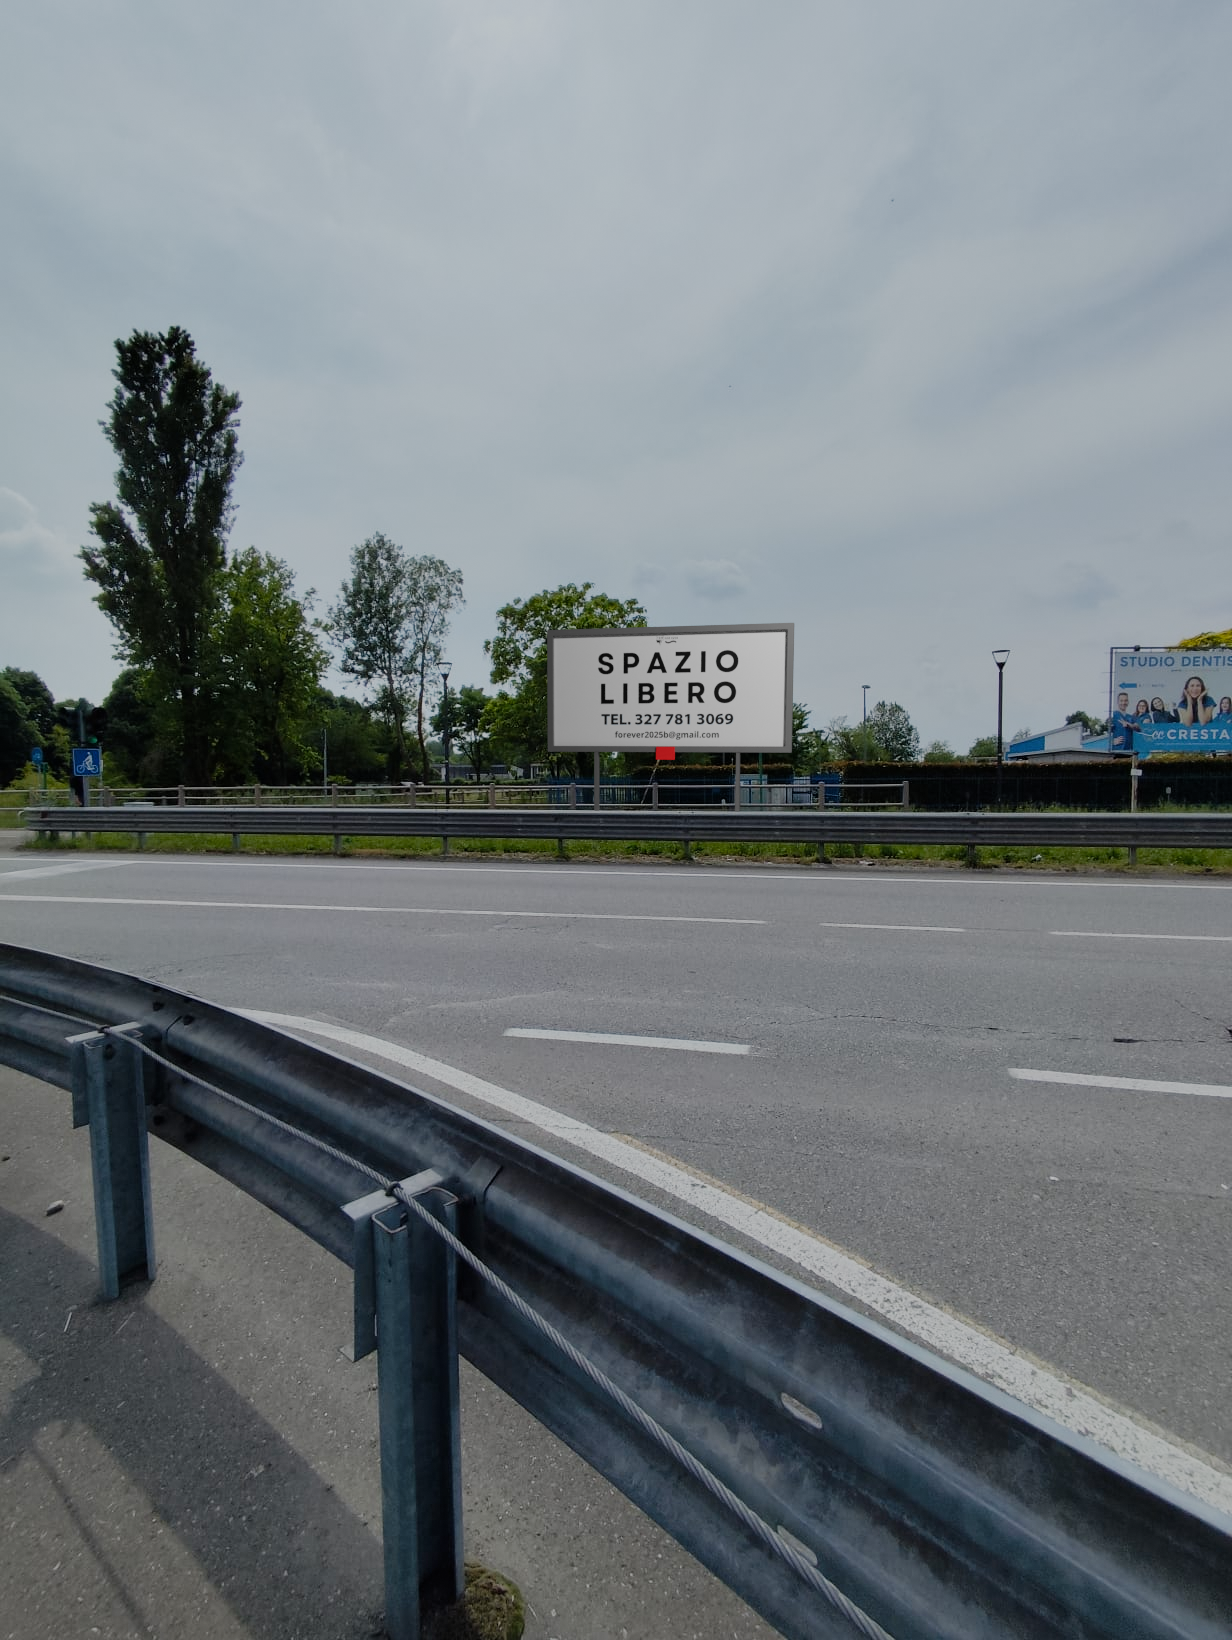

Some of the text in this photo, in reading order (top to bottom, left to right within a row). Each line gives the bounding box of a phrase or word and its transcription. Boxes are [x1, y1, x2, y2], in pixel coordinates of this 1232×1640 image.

[598, 650, 739, 674] SPAZIO
[1120, 656, 1175, 667] STUDIO
[600, 681, 737, 704] LIBERO
[601, 713, 734, 725] TEL. 327 781 3069
[615, 731, 720, 740] forever2025b@gmail.com
